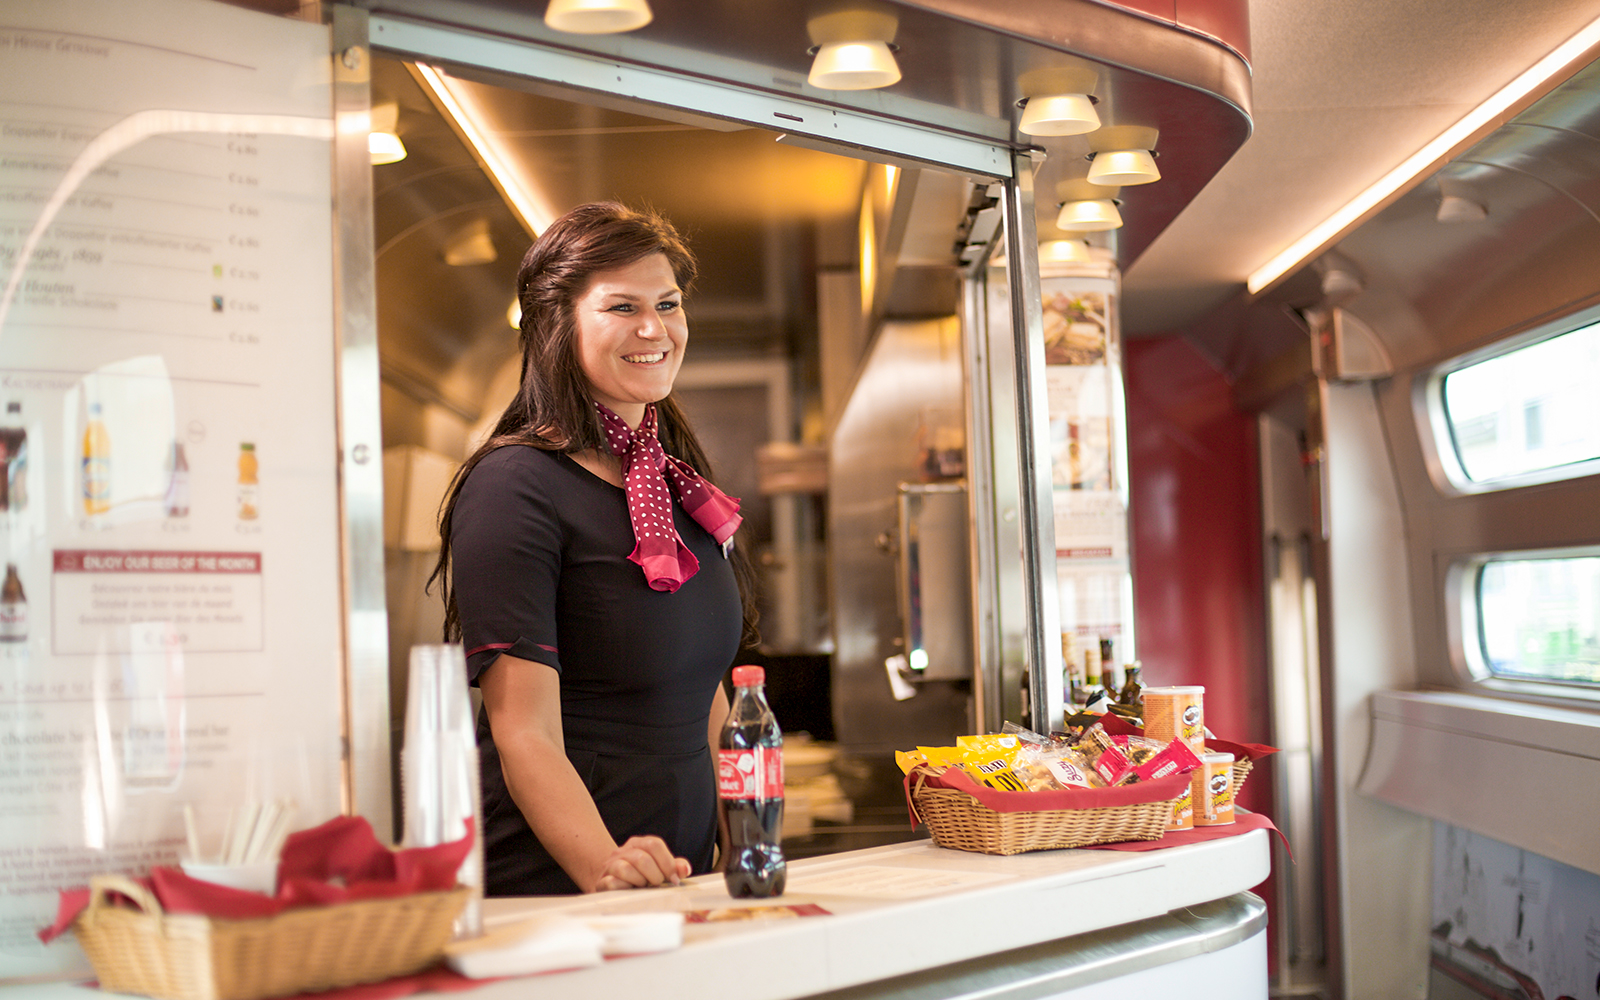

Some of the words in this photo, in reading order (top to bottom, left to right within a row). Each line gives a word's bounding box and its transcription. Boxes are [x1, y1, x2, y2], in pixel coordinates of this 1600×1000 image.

[83, 555, 122, 570] ENJOY
[125, 556, 149, 570] OUR
[151, 556, 178, 570] BEER
[181, 557, 196, 570] OF
[197, 557, 216, 570] THE
[218, 558, 256, 571] MONTH
